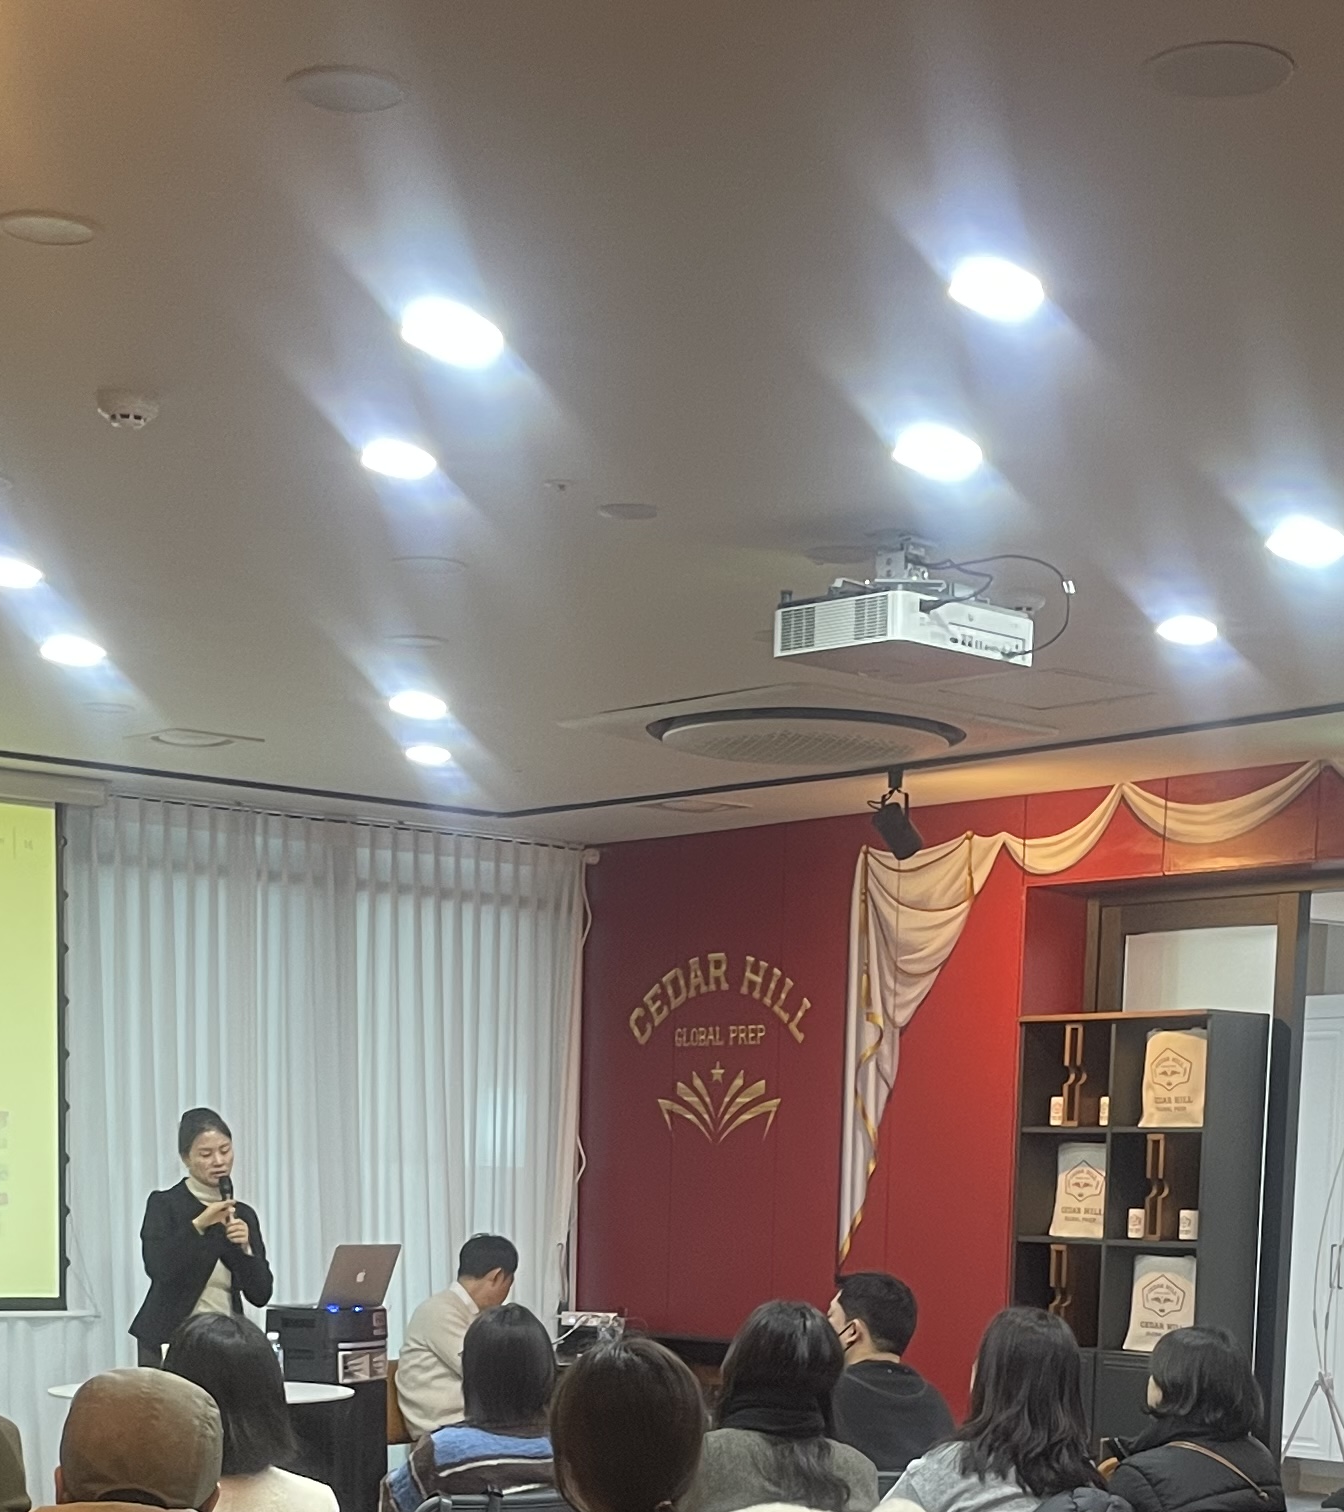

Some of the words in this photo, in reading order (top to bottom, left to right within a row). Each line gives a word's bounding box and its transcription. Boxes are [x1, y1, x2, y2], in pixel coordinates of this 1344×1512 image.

[629, 953, 729, 1045] CEDAR
[740, 955, 811, 1043] HILL
[675, 1026, 724, 1047] GLOBAL
[729, 1025, 766, 1046] PREP
[1140, 1321, 1165, 1330] CEDAR
